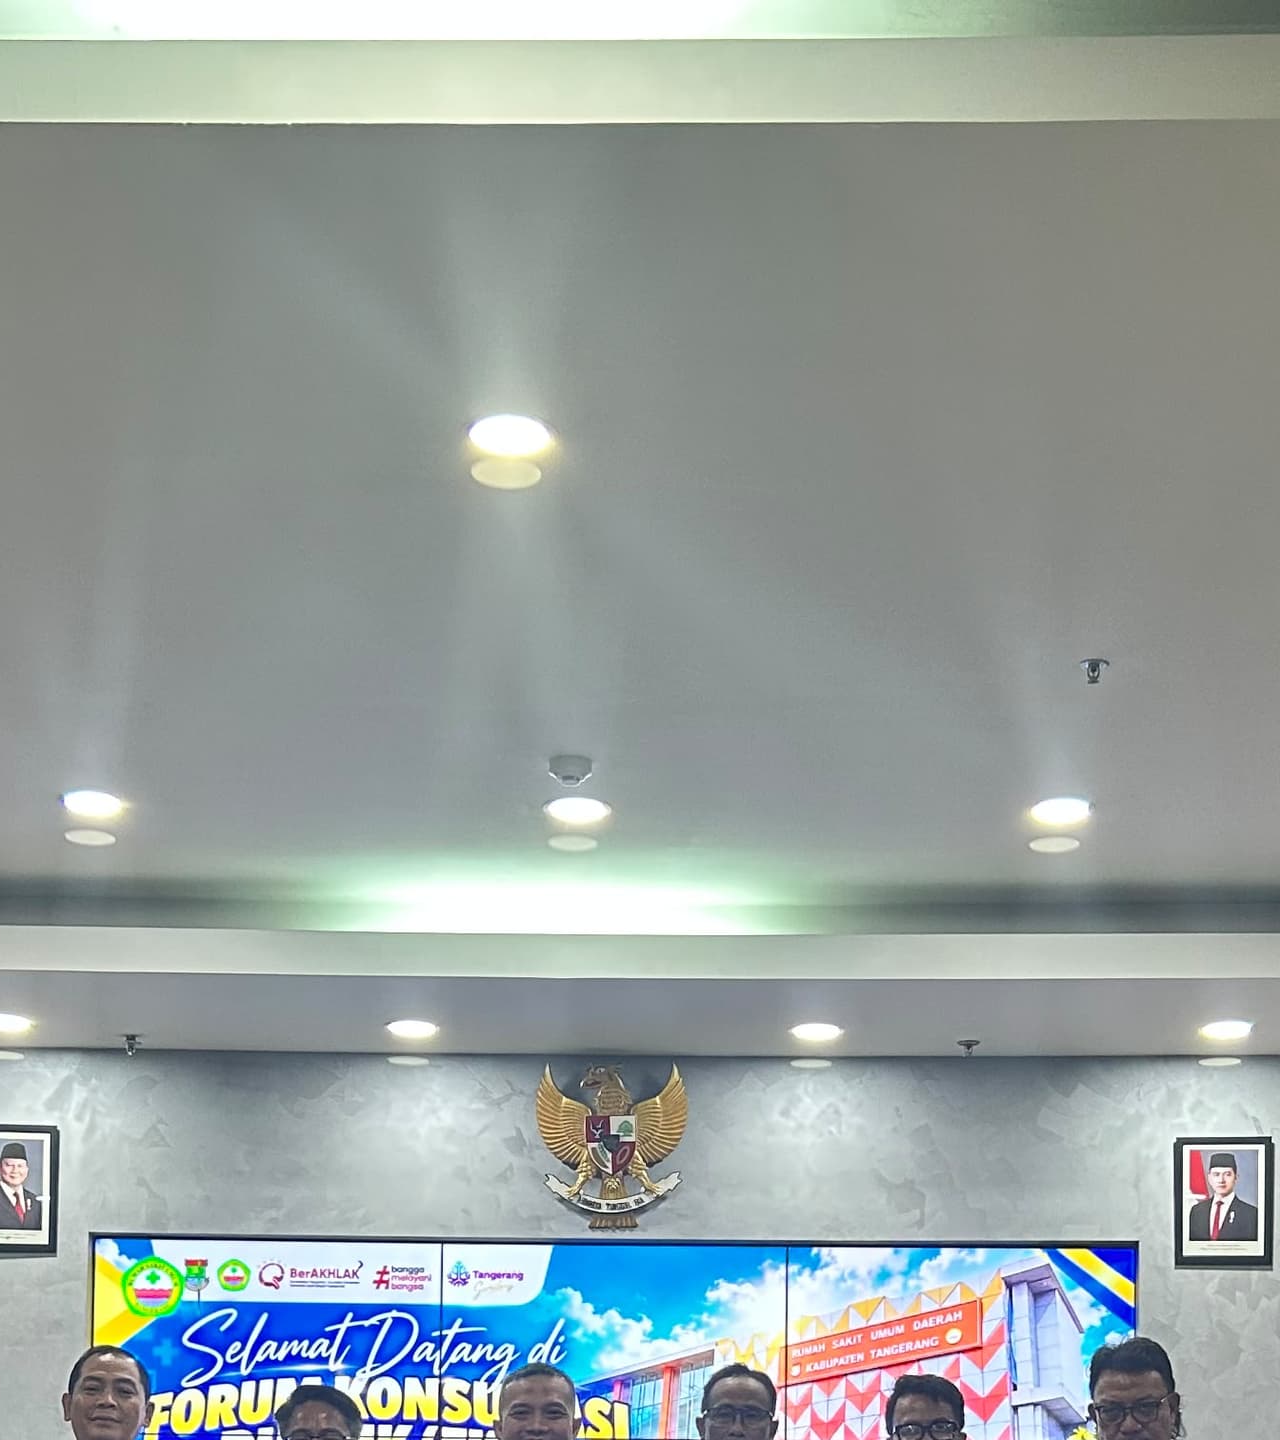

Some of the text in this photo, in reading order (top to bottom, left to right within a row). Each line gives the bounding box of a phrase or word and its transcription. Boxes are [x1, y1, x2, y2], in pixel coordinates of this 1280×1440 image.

[290, 1267, 360, 1279] BerAKHLAK
[391, 1266, 425, 1274] bangga
[472, 1270, 524, 1281] Tangerang
[791, 1310, 963, 1359] RUMAH SAKIT UMUM DAERAH
[181, 1308, 569, 1393] Selamat Datang di
[805, 1336, 939, 1373] KABUPATEN TANGERANG
